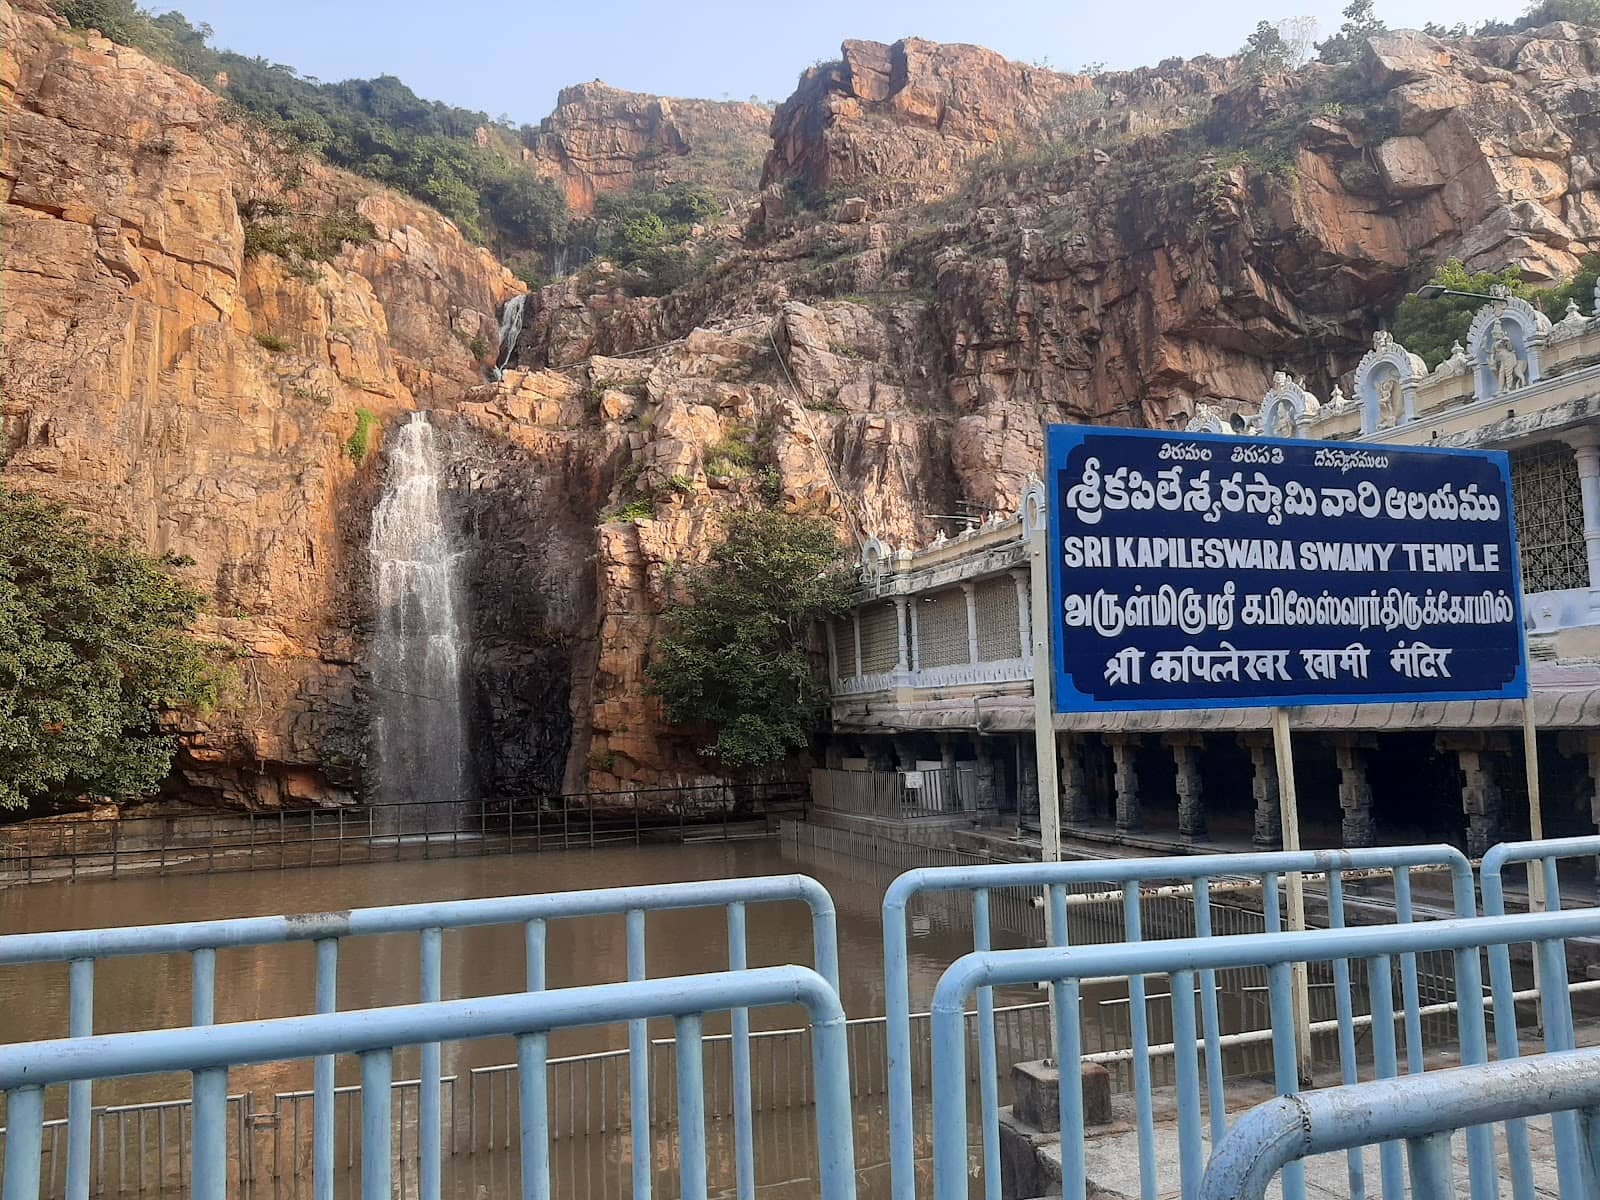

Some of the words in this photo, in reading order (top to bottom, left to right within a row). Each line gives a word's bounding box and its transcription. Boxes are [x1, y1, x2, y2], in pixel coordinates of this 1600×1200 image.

[1158, 442, 1212, 461] తిరుమల
[1230, 445, 1284, 464] తిరుపతి
[1314, 449, 1389, 475] దేవస్థానములు
[1320, 481, 1382, 519] వారి
[1384, 483, 1501, 521] ఆలయము
[1065, 536, 1112, 568] SRI
[1116, 537, 1297, 570] KAPILESWARA
[1300, 542, 1396, 572] SWAMY
[1402, 544, 1500, 572] TEMPLE
[1104, 647, 1146, 686] श्री
[1390, 641, 1453, 678] मंदिर
